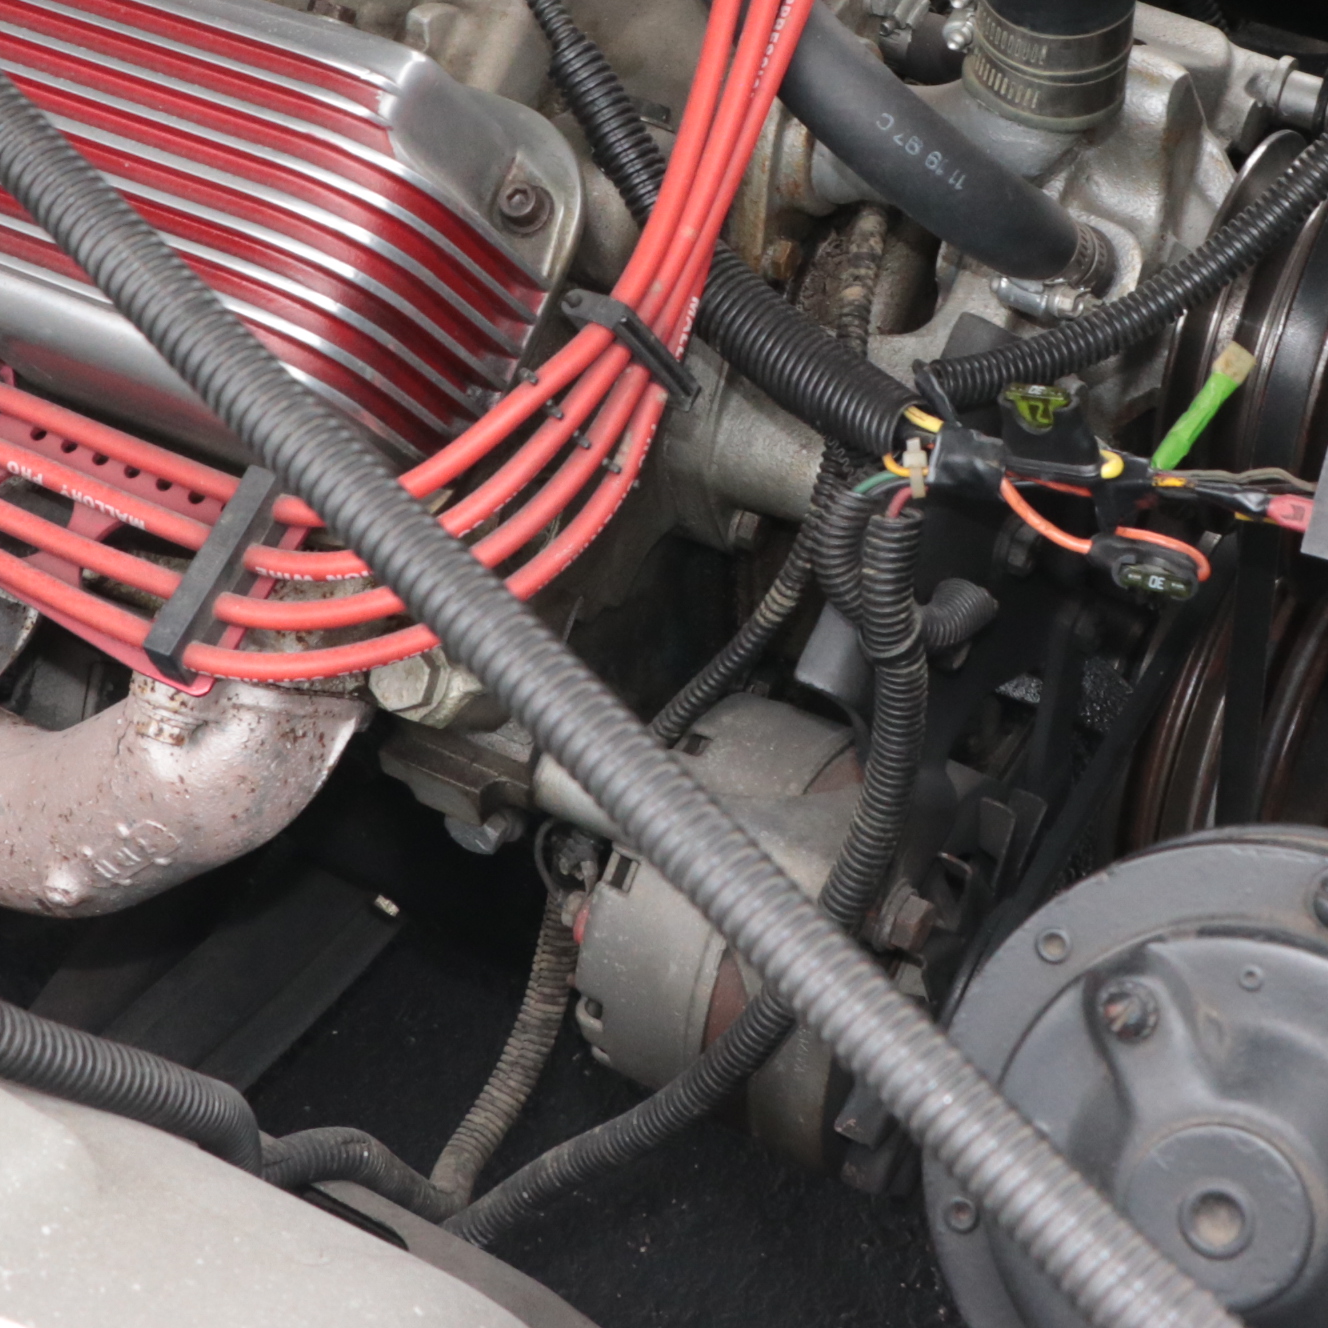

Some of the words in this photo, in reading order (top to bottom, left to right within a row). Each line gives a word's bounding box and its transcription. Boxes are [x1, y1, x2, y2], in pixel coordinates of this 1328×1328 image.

[6, 460, 44, 486] PRO
[60, 484, 146, 531] MALLORY
[1148, 575, 1166, 590] 30
